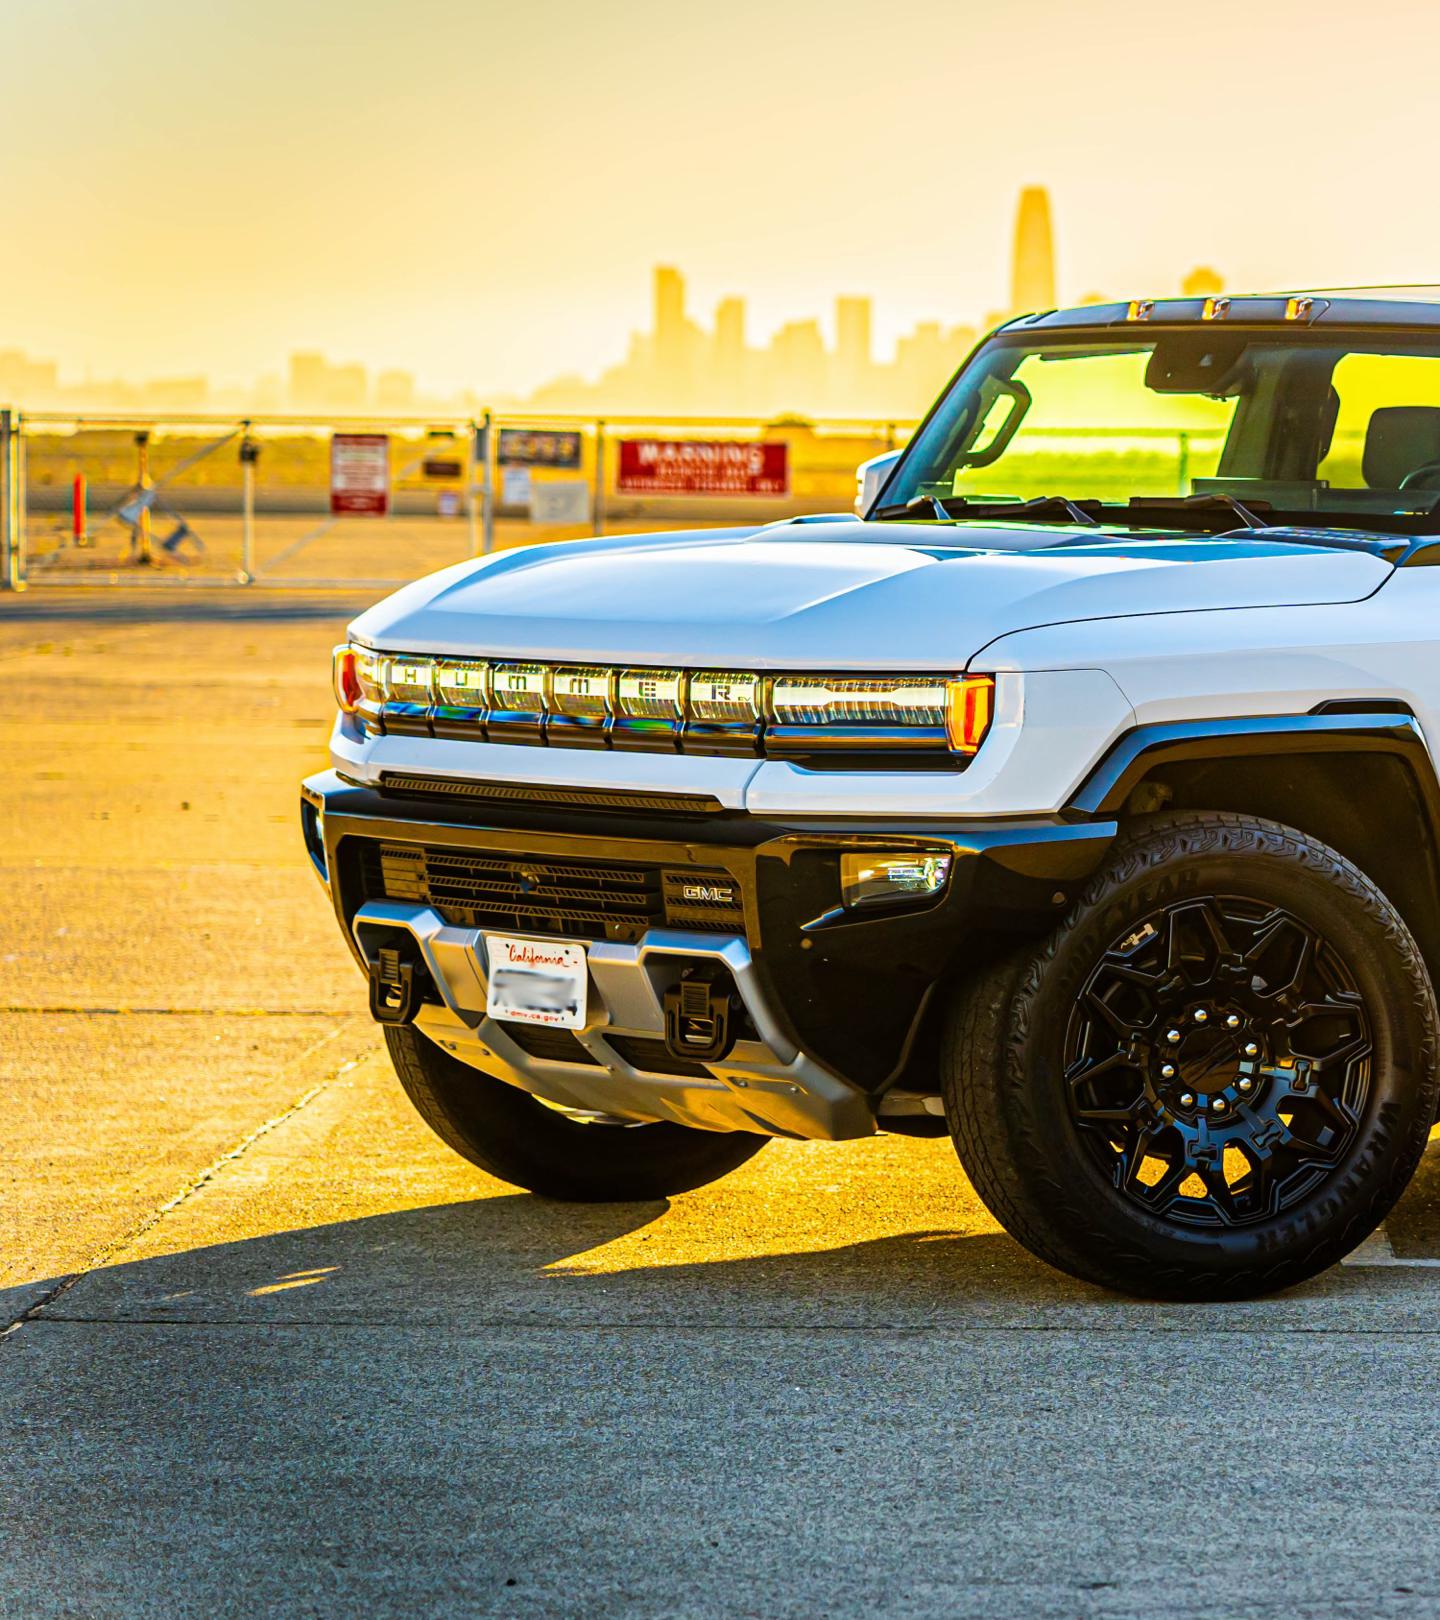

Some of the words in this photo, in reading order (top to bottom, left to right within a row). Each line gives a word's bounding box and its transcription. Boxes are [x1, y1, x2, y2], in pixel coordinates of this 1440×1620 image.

[639, 443, 765, 475] WARNING
[404, 668, 731, 701] HUMMER
[683, 885, 733, 902] GMC
[509, 943, 567, 967] California
[1253, 1101, 1402, 1254] WRANGLER
